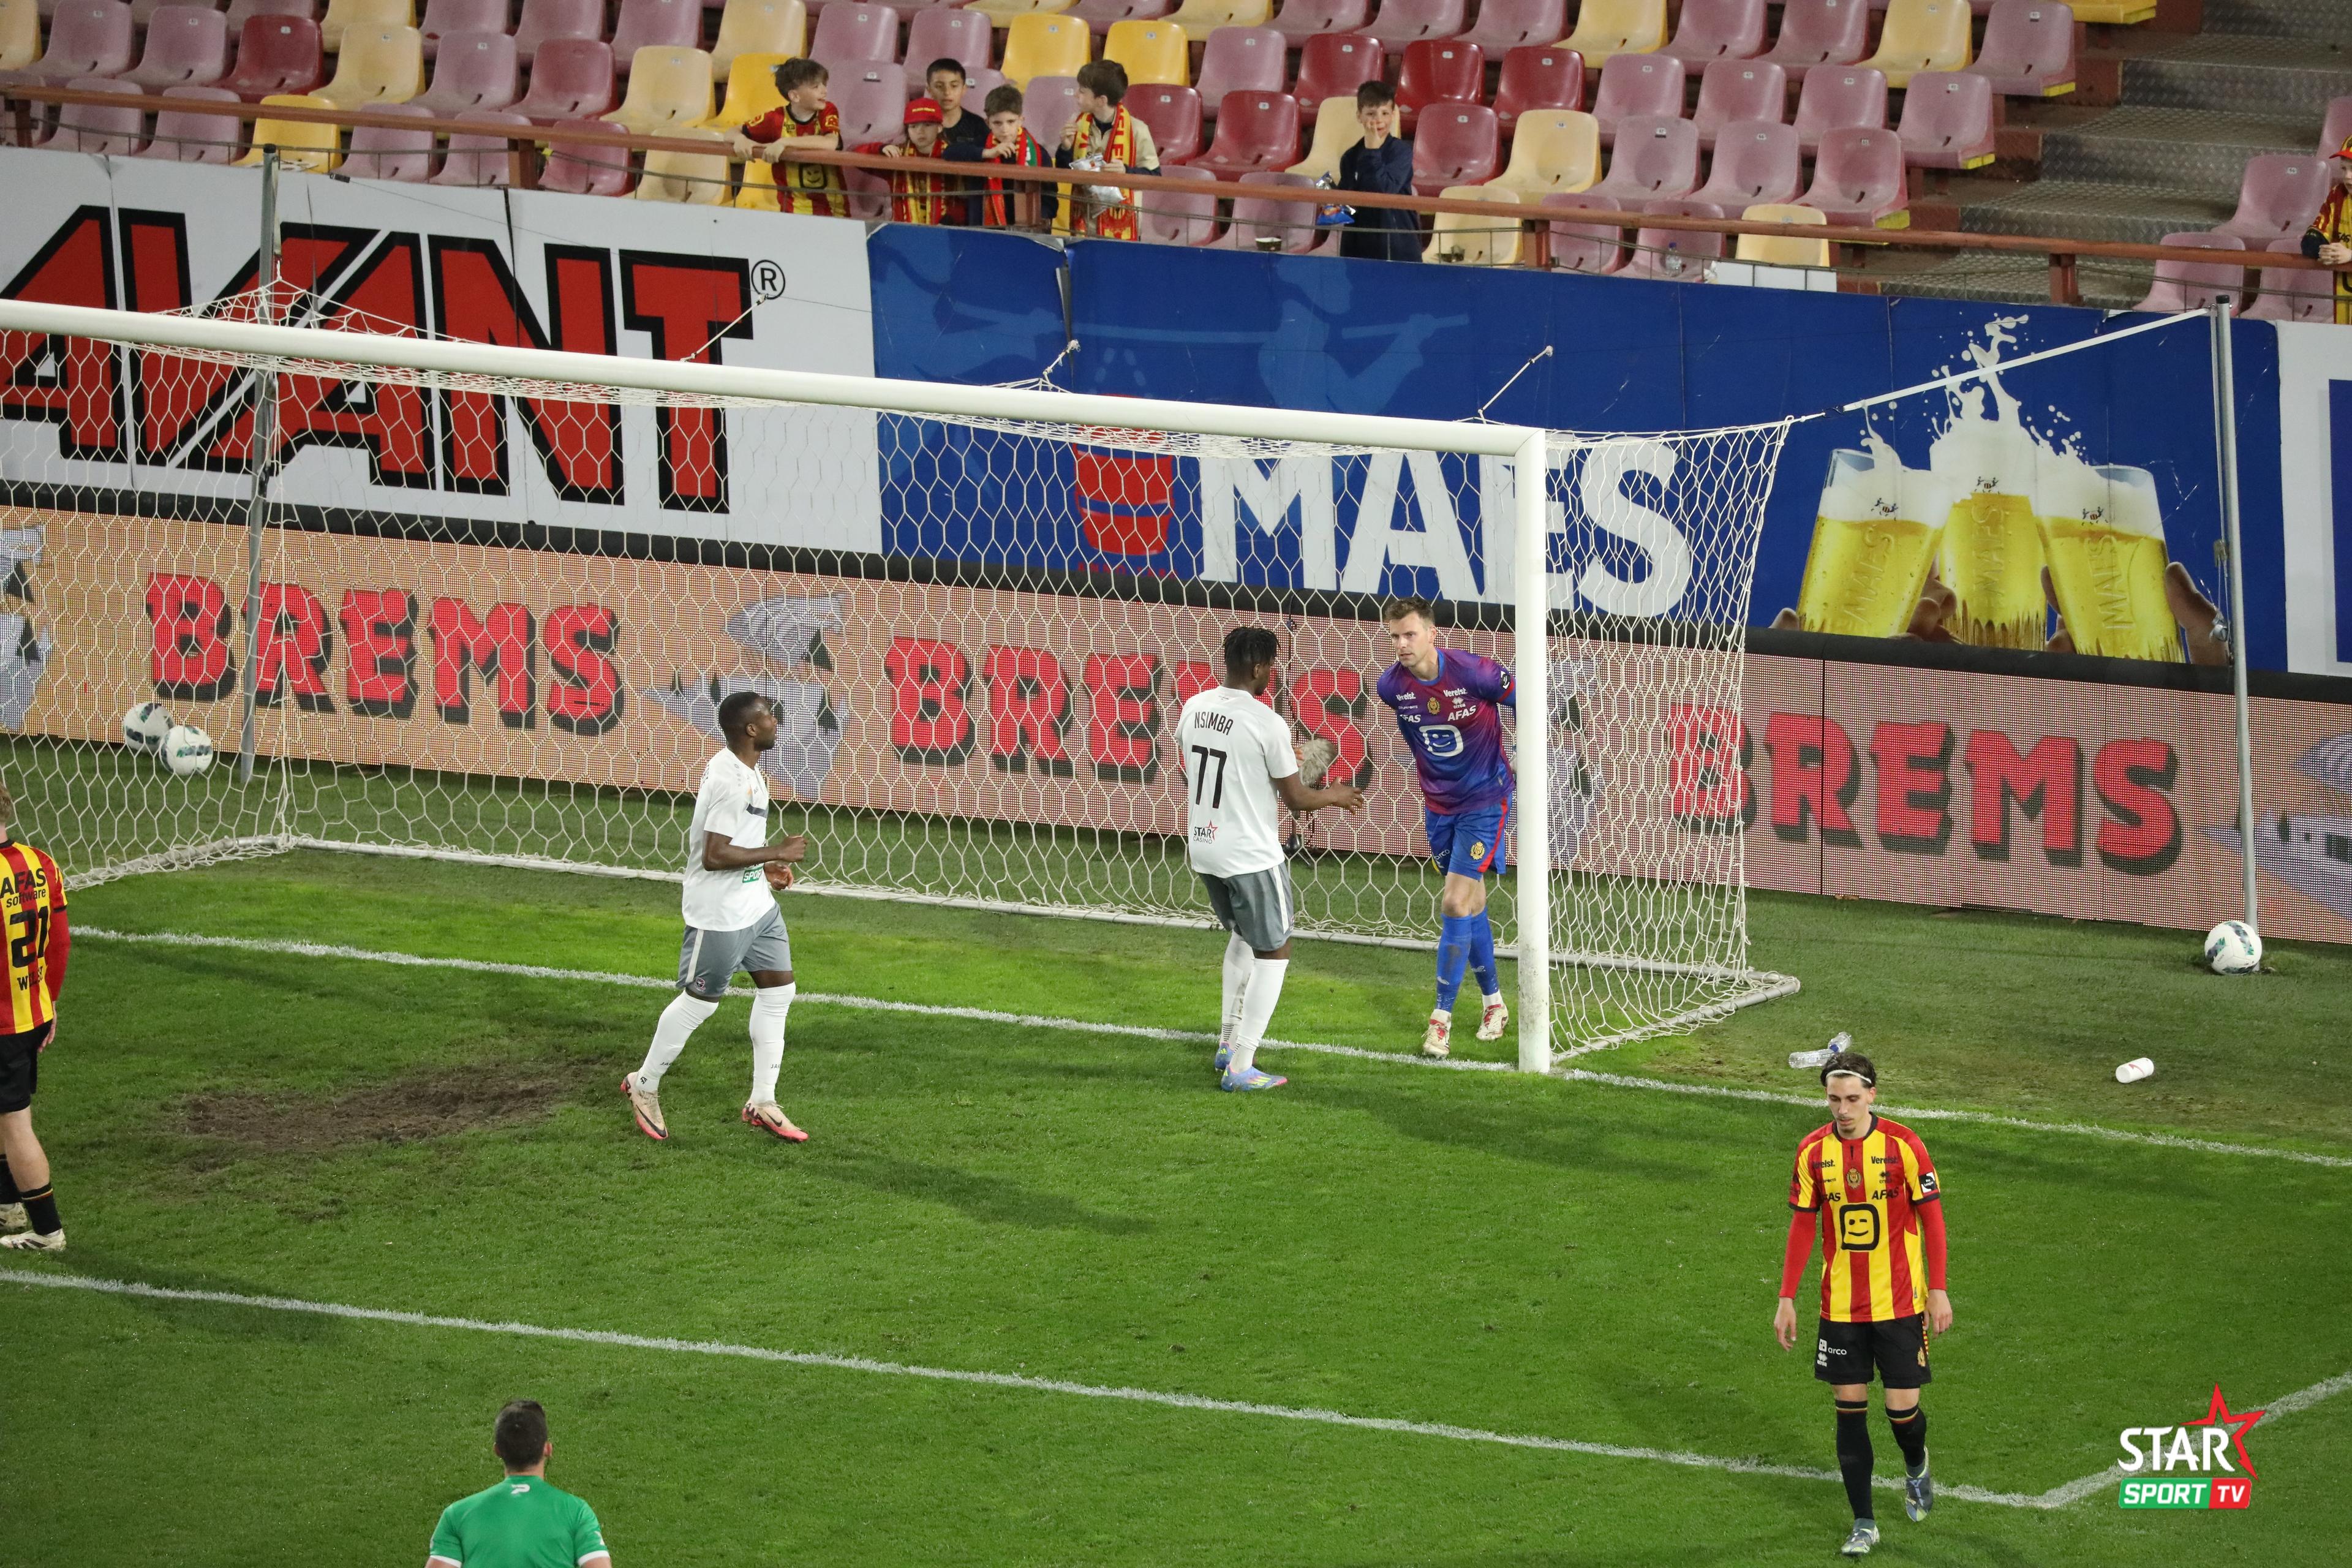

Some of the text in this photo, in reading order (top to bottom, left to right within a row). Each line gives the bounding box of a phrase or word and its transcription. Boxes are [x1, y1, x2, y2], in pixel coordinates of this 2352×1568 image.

[0, 204, 753, 513] AVANT
[1200, 439, 1691, 618] MAES
[2084, 535, 2136, 629] MAES
[146, 571, 624, 736] BREMS
[1194, 711, 1234, 736] NSIMBA
[1447, 705, 1476, 722] AFAS
[1191, 744, 1227, 809] 77
[1668, 703, 2181, 876] BREMS
[1193, 826, 1212, 838] STAR
[0, 867, 47, 899] AFAS
[6, 888, 47, 908] software
[9, 905, 49, 968] 21
[1872, 1186, 1899, 1200] AFAS
